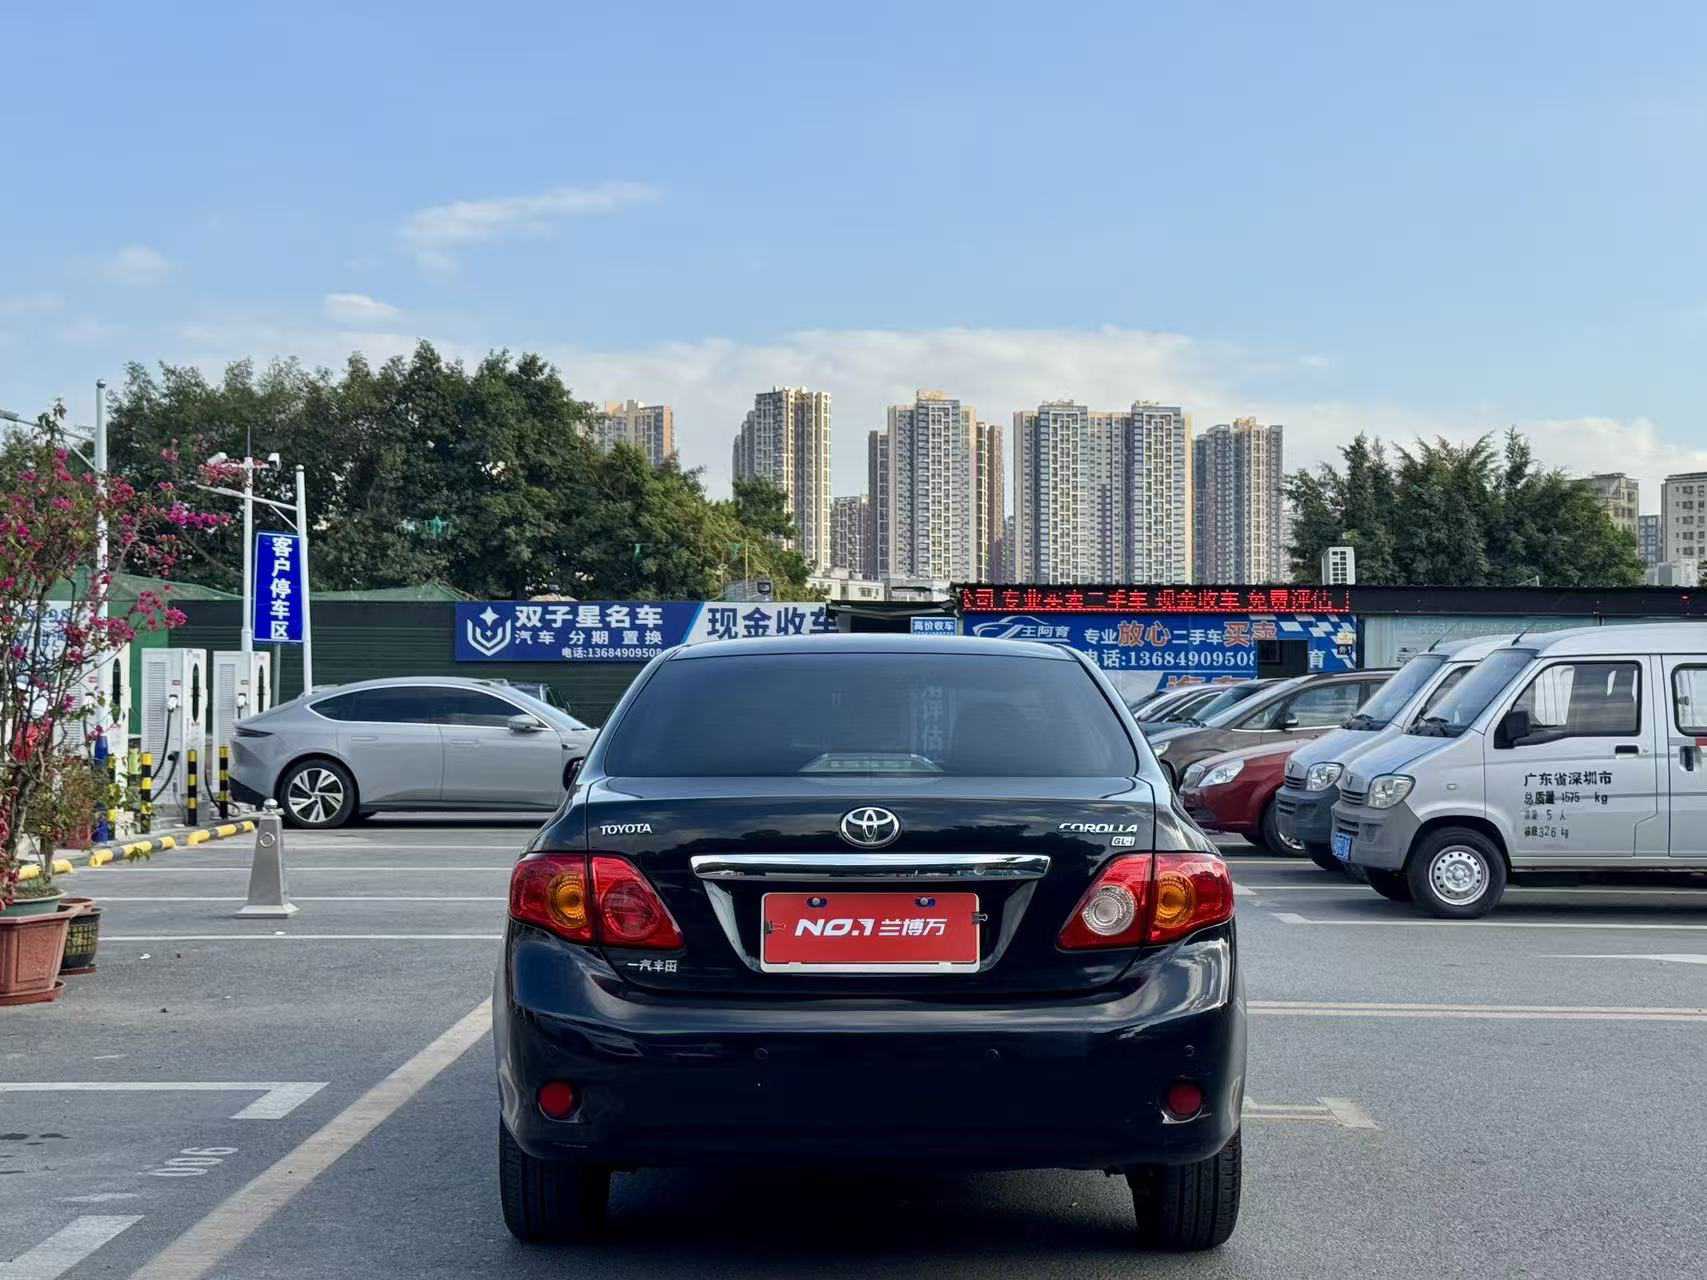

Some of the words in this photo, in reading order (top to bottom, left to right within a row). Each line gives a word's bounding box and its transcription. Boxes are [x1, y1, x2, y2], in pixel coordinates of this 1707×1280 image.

[270, 536, 292, 640] 客户停车区
[514, 605, 664, 628] 双子星名车
[514, 630, 556, 645] 汽车
[568, 630, 610, 645] 分期
[621, 630, 664, 645] 置换
[1523, 770, 1613, 787] 广东省深圳市
[1594, 791, 1608, 805] kg
[600, 823, 653, 836] TOYOTA
[1058, 822, 1138, 833] COROLLA
[795, 918, 875, 937] NO.1
[878, 918, 948, 937] 兰博万
[626, 959, 677, 973] 一汽丰田
